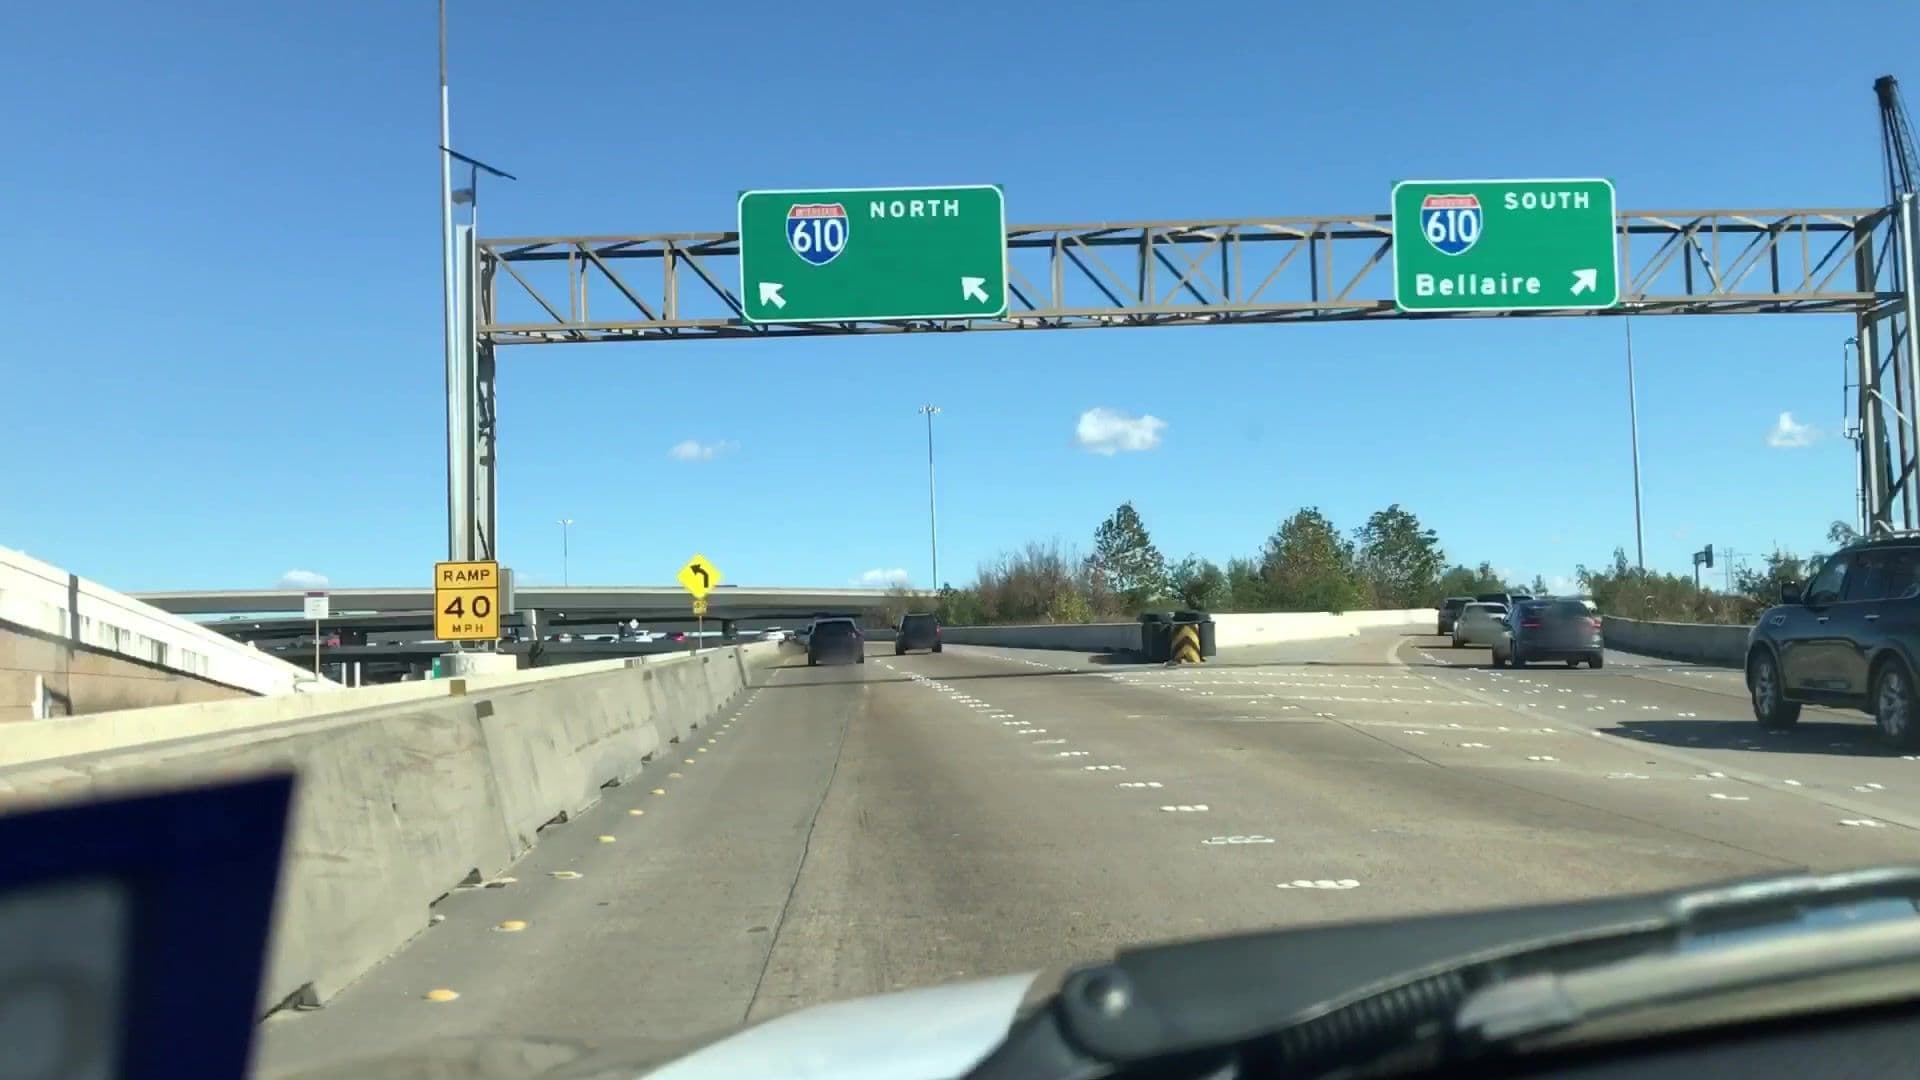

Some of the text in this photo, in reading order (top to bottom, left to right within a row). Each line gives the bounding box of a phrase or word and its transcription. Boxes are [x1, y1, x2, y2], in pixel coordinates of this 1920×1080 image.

[870, 199, 960, 218] NORTH
[1504, 191, 1590, 210] SOUTH
[793, 219, 844, 252] 610
[1427, 209, 1478, 243] 610
[1415, 272, 1541, 296] Bellaire
[443, 569, 490, 582] RAMP
[444, 595, 491, 618] 40
[452, 623, 484, 633] MPH
